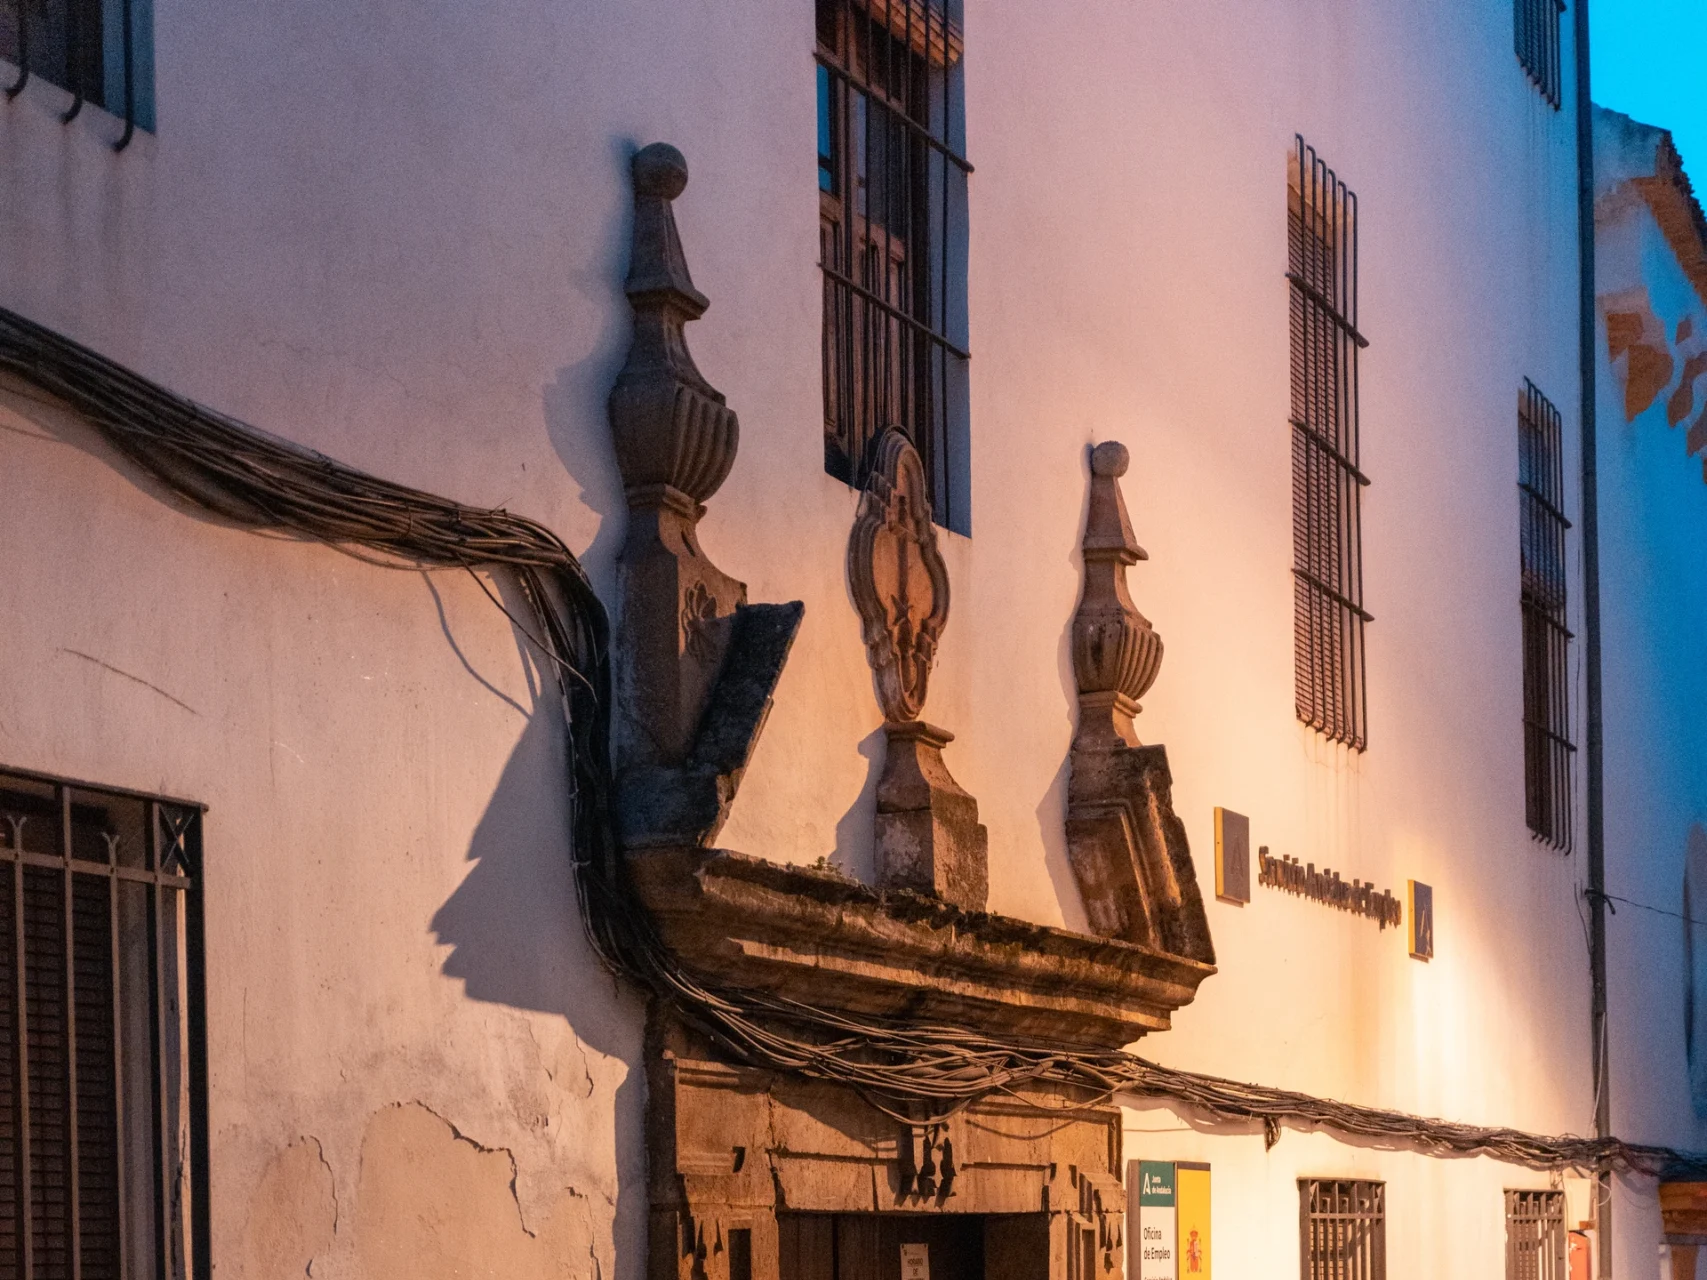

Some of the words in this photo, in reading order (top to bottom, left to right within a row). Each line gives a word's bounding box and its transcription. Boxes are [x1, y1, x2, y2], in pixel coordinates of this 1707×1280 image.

[1143, 1227, 1162, 1240] Oficina
[1143, 1247, 1150, 1260] de
[1151, 1247, 1171, 1262] Empleo
